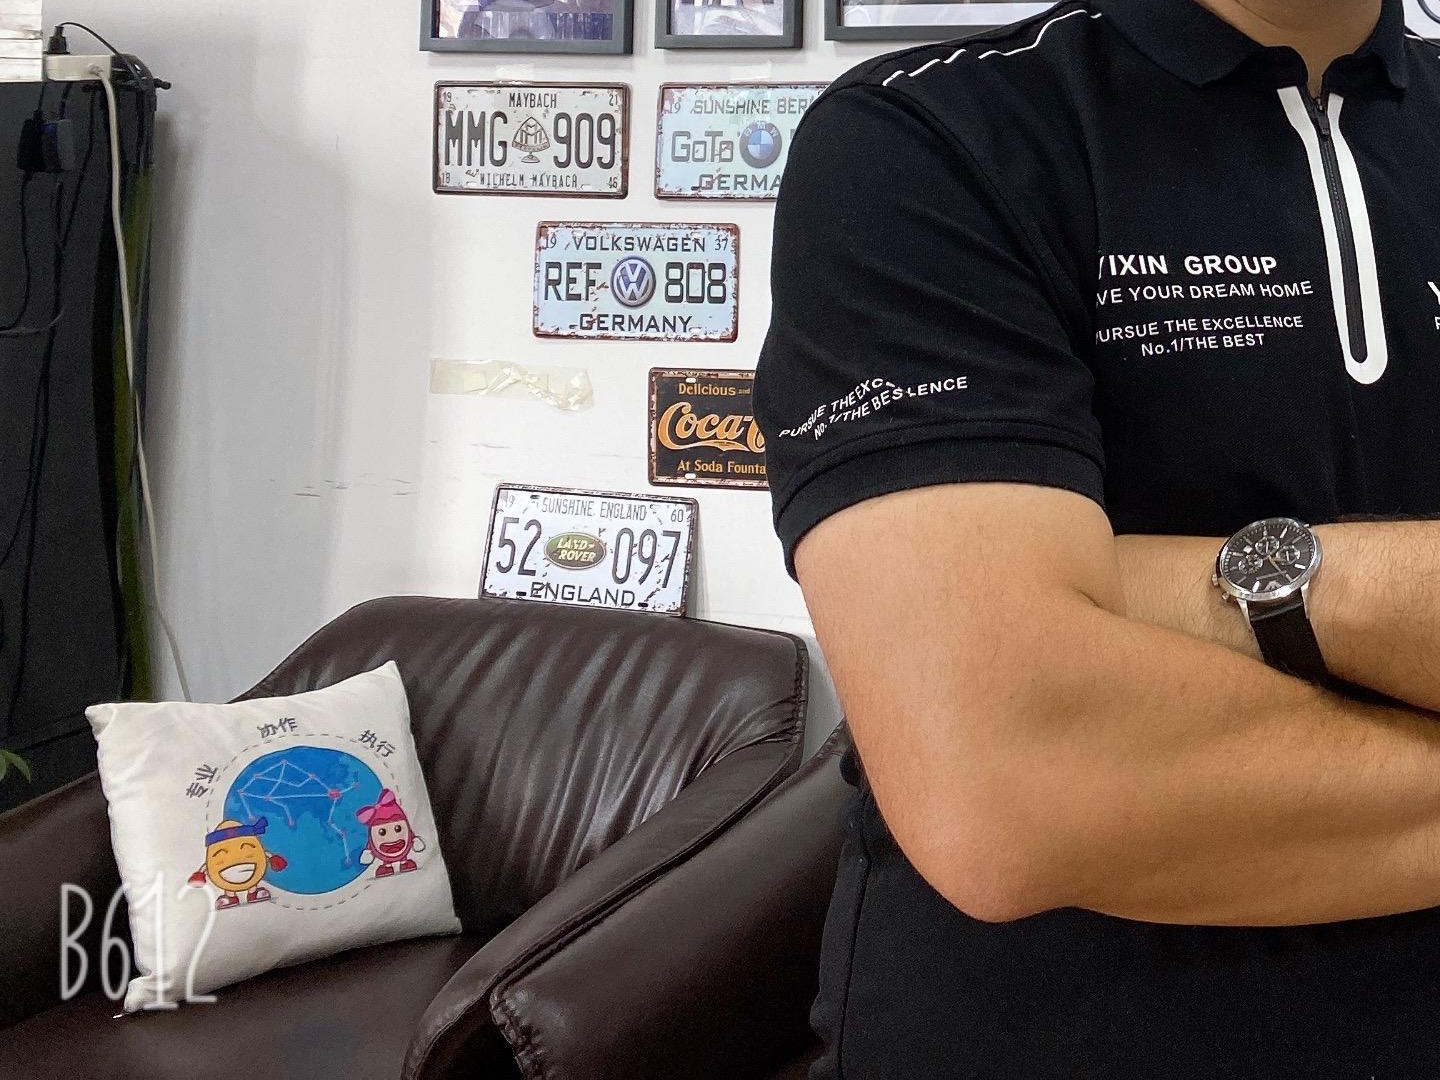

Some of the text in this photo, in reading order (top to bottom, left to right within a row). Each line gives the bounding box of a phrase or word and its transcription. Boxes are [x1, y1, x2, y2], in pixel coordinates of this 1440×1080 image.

[509, 93, 557, 108] MAYBACH
[694, 99, 770, 114] SUNSHINE
[777, 98, 813, 114] BER
[444, 110, 616, 170] MMG 909
[480, 173, 524, 188] WILHELM
[532, 173, 578, 189] MAYBACH
[572, 235, 706, 252] VOLKSWAGEN
[714, 237, 729, 251] 37
[1184, 255, 1277, 275] GROUP
[544, 261, 602, 301] REF
[664, 261, 727, 304] 808
[1129, 285, 1185, 302] YOUR
[1189, 283, 1255, 299] DREAM
[1259, 280, 1314, 298] HOME
[579, 313, 693, 333] GERMANY
[1096, 315, 1304, 344] URSUE THE EXCELLENCE
[1223, 333, 1266, 348] BEST
[678, 383, 736, 396] Delicious
[779, 404, 827, 437] PURSUE
[678, 460, 690, 471] At
[694, 460, 723, 472] Soda
[541, 497, 595, 517] SUNSHINE
[600, 501, 648, 521] ENGLAND
[670, 509, 684, 523] 60
[496, 516, 542, 577] 52
[558, 549, 596, 562] ROVER
[612, 527, 681, 588] 097
[530, 581, 635, 607] ENGLAND
[187, 717, 396, 800] 专业 协作 执行
